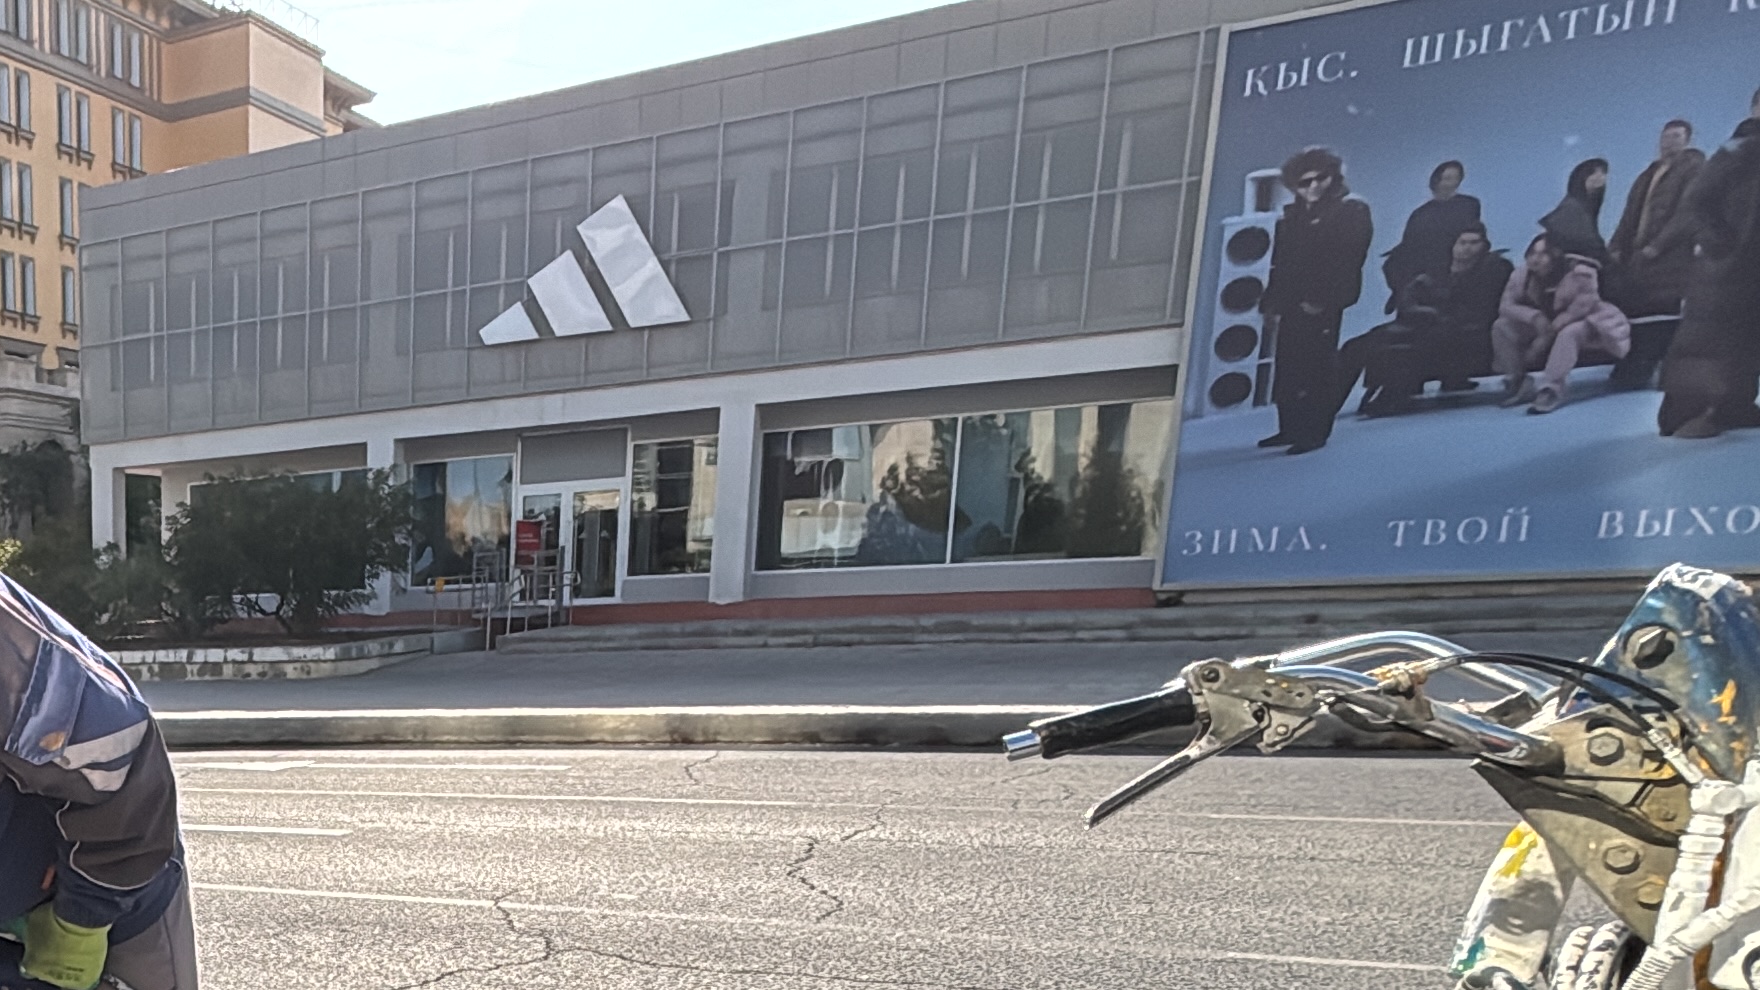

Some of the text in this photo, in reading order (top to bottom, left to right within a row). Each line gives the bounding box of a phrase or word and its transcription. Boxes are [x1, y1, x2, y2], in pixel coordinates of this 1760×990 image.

[1181, 503, 1760, 556] ЗИМА. ТВОЙ ВЫХО
